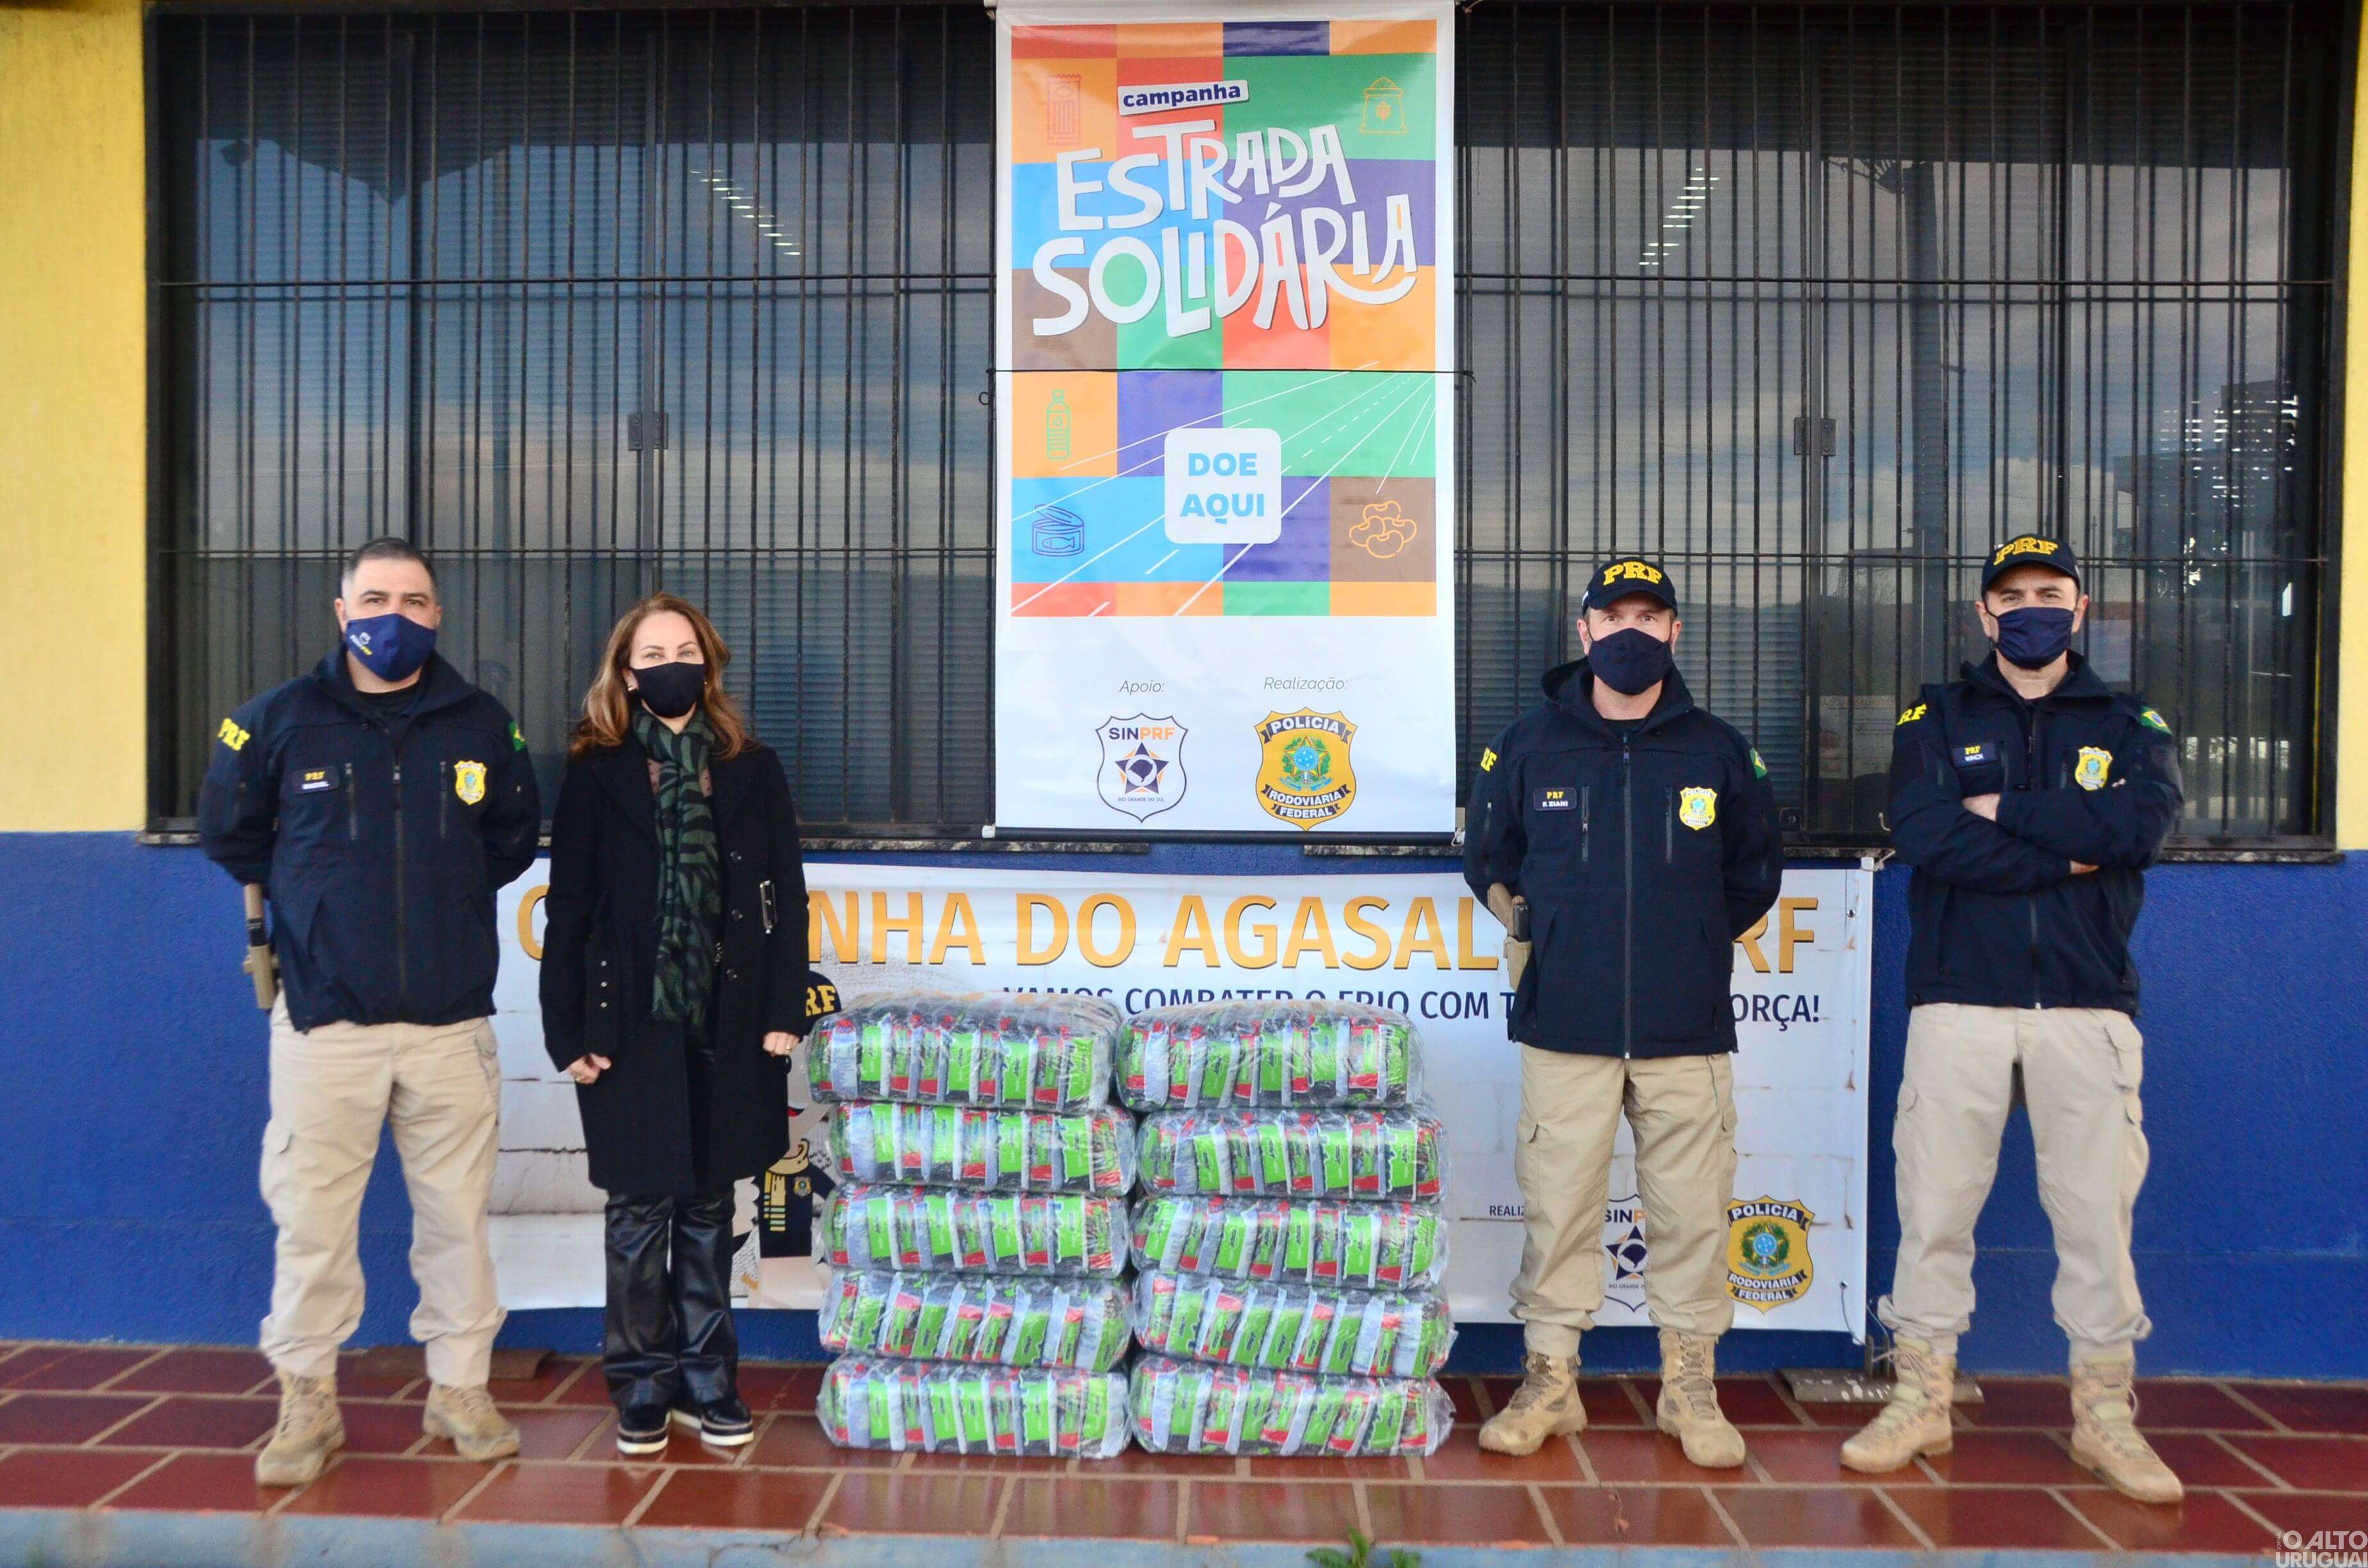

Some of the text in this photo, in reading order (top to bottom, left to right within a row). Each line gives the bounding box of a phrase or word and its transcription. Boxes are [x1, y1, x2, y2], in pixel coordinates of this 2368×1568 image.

[1122, 84, 1241, 109] campanha
[1057, 118, 1356, 231] ESTRADA
[1032, 193, 1418, 338] SOLIDÁRIA
[1187, 452, 1258, 477] DOE
[1180, 494, 1265, 524] AQUI
[1993, 537, 2059, 566] PRF
[1603, 561, 1663, 585] PRF
[1119, 680, 1165, 696] Apoio:
[1263, 676, 1348, 692] Realização:
[217, 717, 251, 751] PRF
[1108, 726, 1176, 740] SINPRF
[1546, 791, 1565, 799] PRF
[1279, 806, 1333, 819] FEDERAL
[1015, 892, 1137, 968] DO
[1163, 894, 1501, 971] AGASAL
[1420, 991, 1489, 1019] COM
[1731, 993, 1819, 1032] ORÇA!
[1738, 1289, 1790, 1301] FEDERAL
